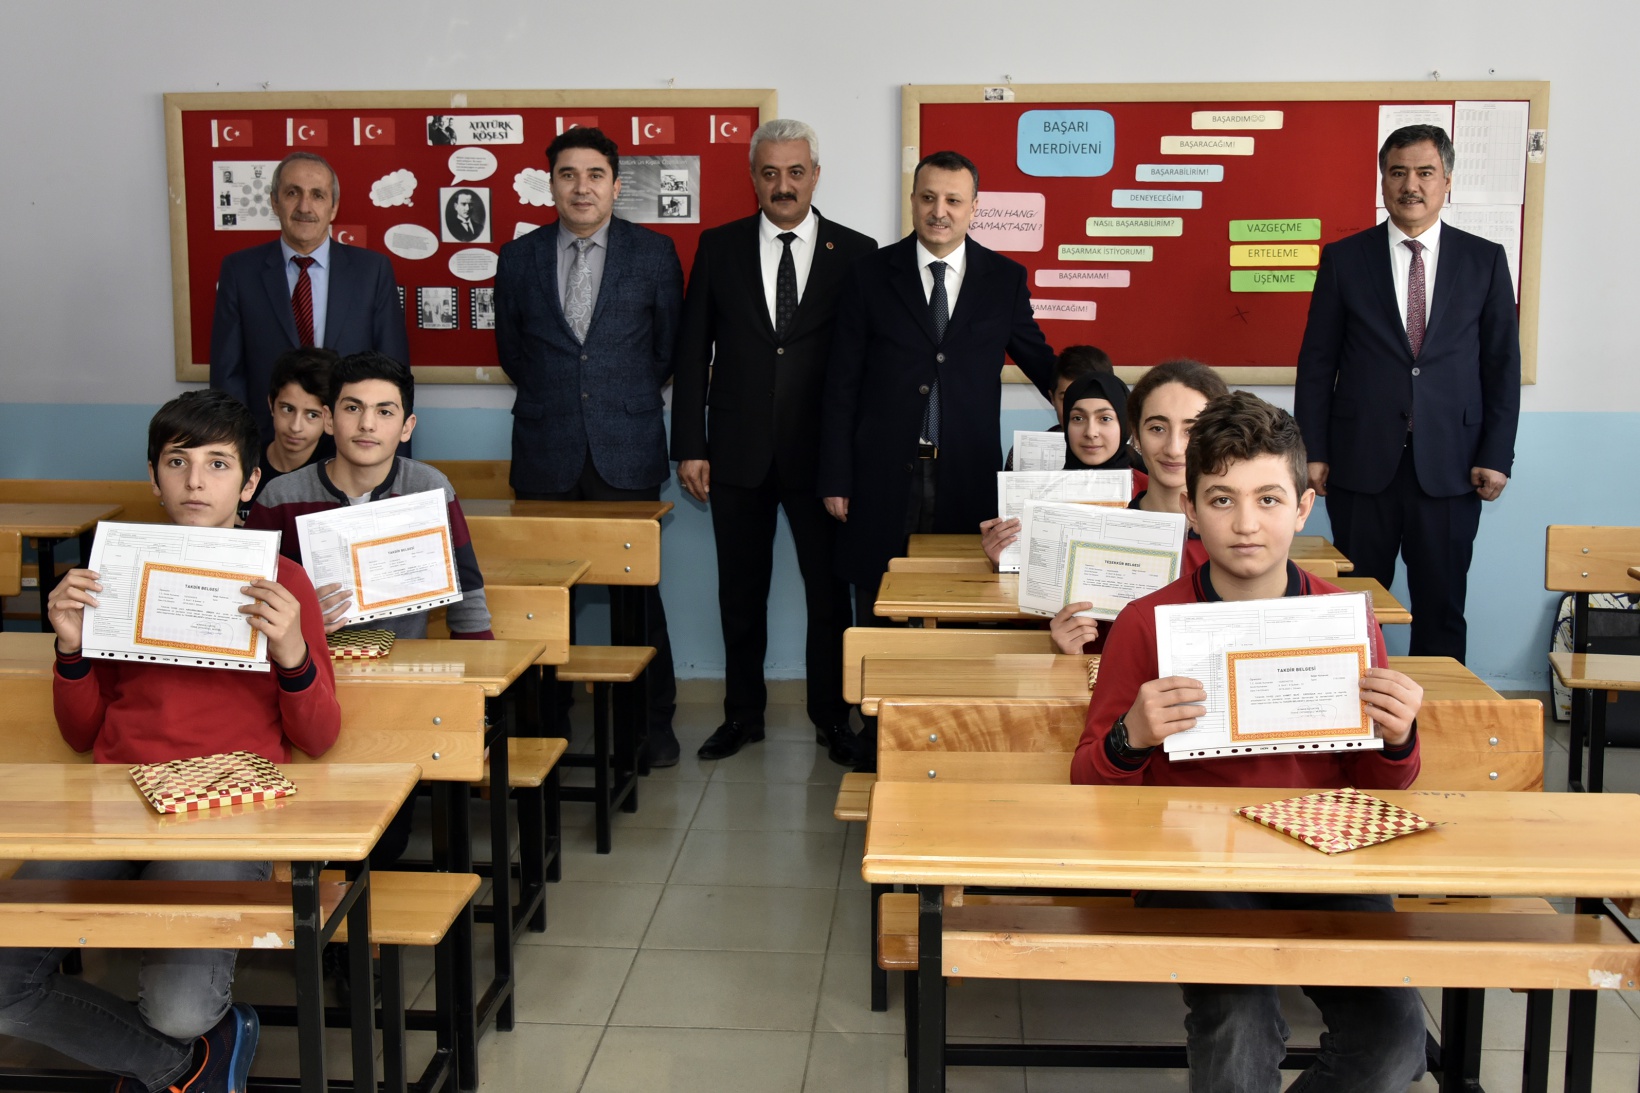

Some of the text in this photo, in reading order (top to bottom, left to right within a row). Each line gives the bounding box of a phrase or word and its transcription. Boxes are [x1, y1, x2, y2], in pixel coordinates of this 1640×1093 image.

[469, 119, 513, 130] ATATÜRK
[1212, 115, 1250, 124] BAŞARDIM
[1043, 121, 1088, 135] BAŞARI
[1029, 141, 1102, 154] MERDİVENİ
[1179, 139, 1235, 150] BAŞARACAĞIM!
[1150, 167, 1209, 177] BAŞARABİLİRİM!
[1129, 193, 1184, 202] DENEYECEĞİM!
[974, 208, 1003, 218] UGÜN
[1093, 219, 1175, 229] NASIL BAŞARABİLİRİM?
[1247, 222, 1302, 234] VAZGEÇME
[1061, 247, 1145, 255] BAŞARMAK İSTİYORUM!
[1248, 248, 1298, 257] ERTELEME
[1058, 272, 1109, 281] BAŞARAMAM!
[1253, 272, 1295, 284] ÜŞENME
